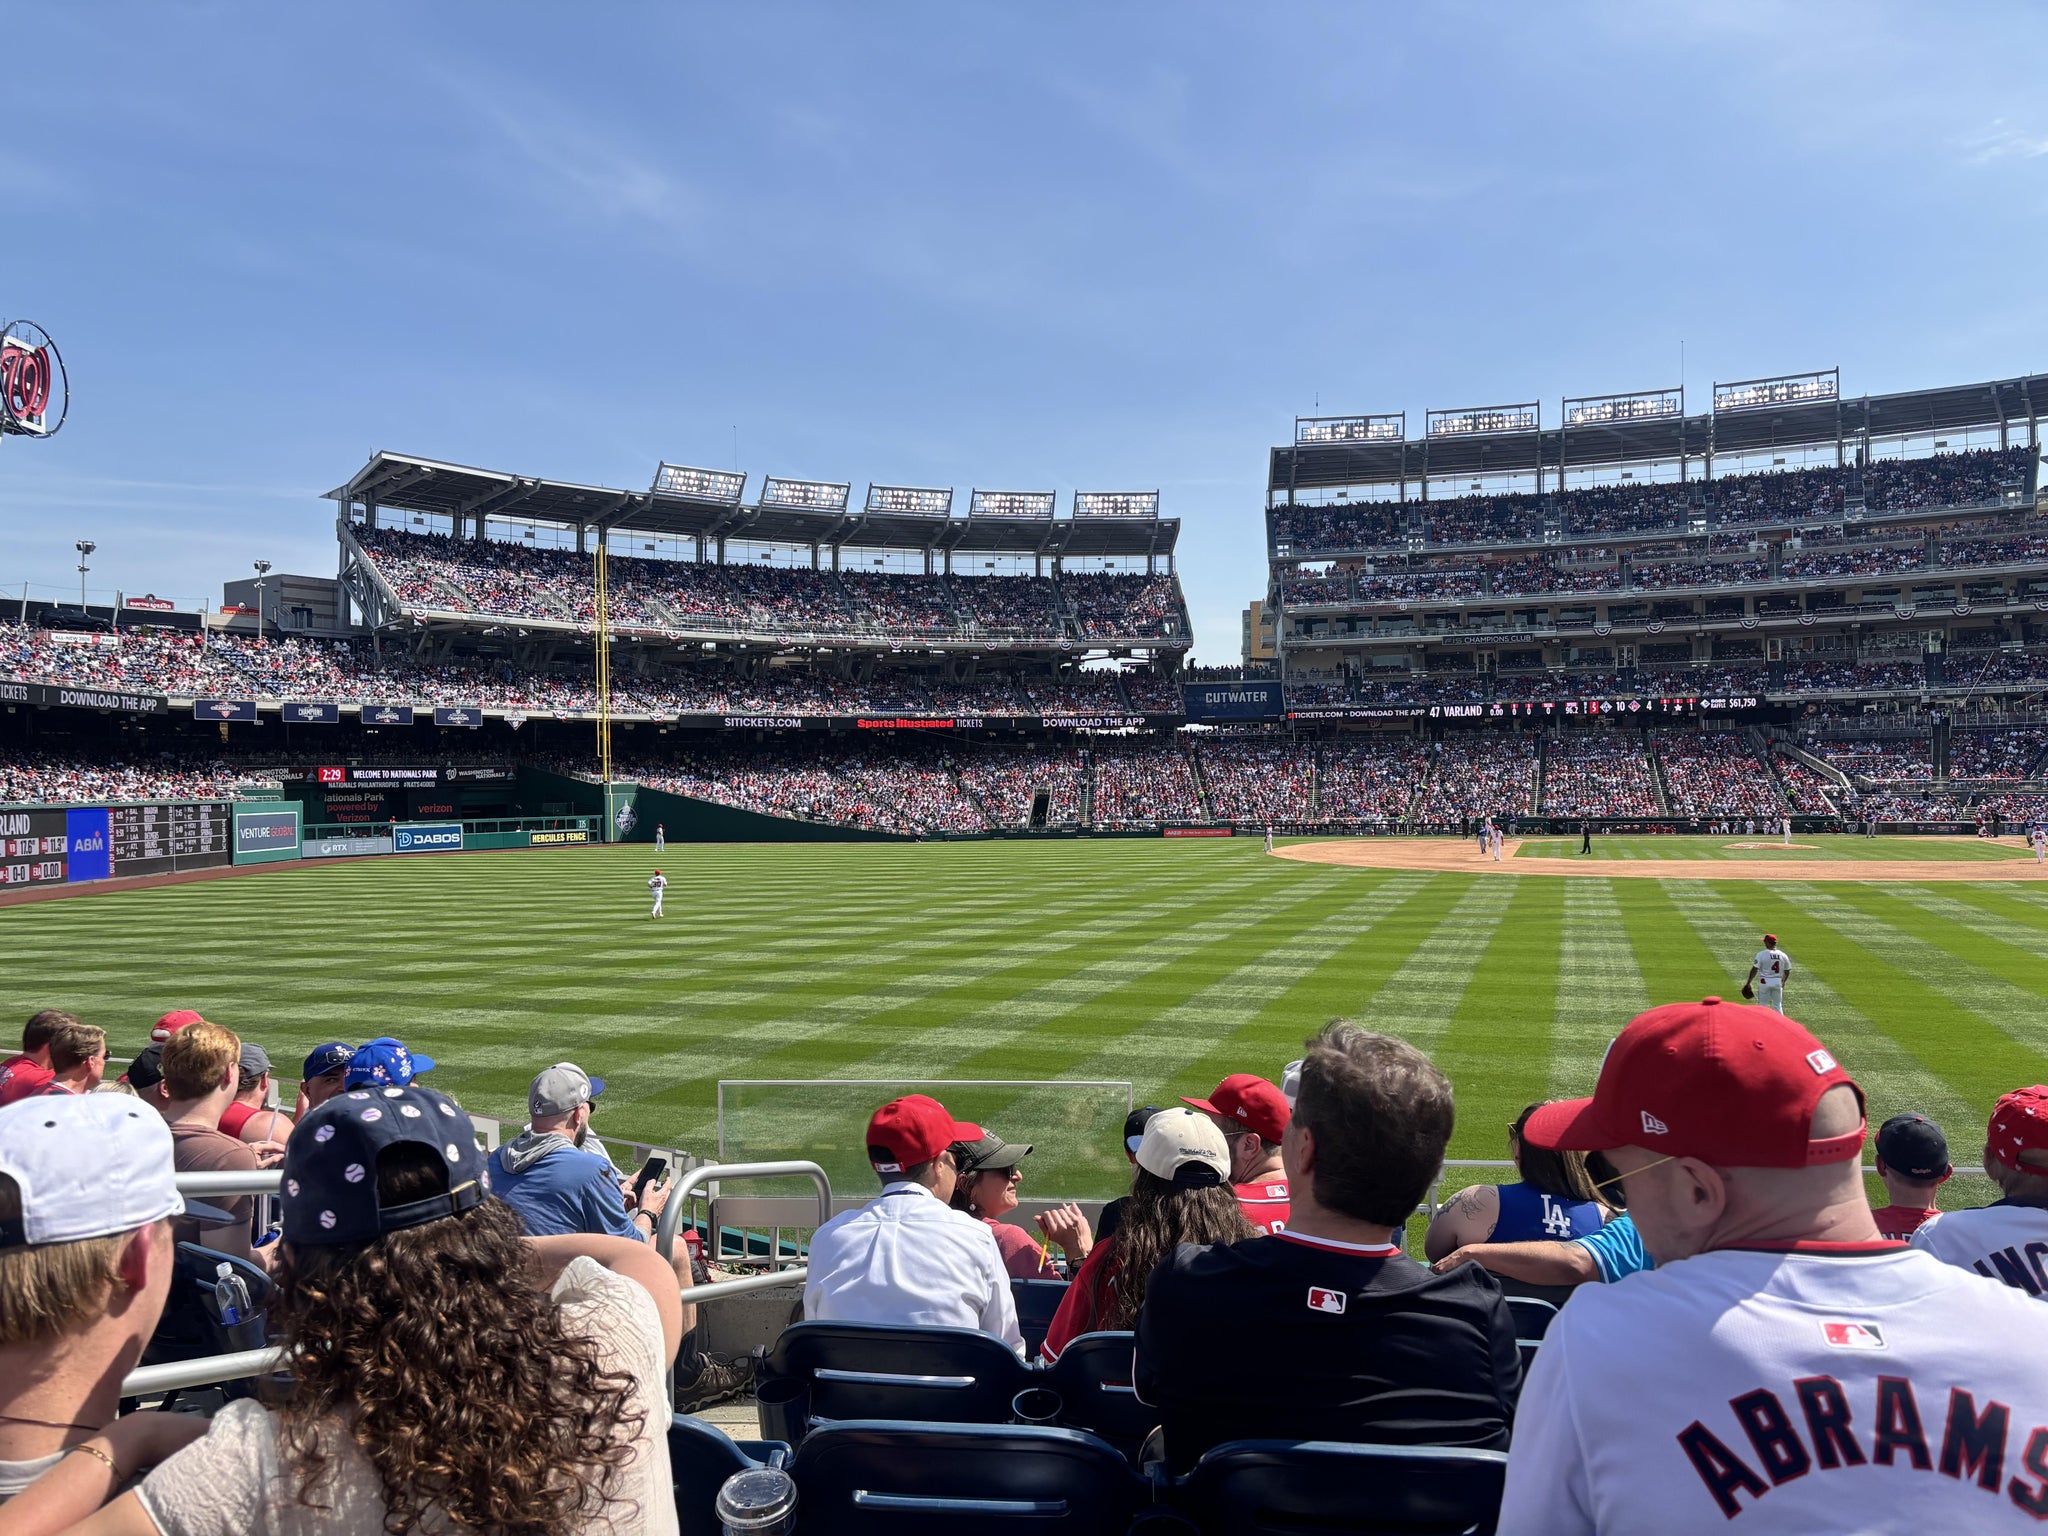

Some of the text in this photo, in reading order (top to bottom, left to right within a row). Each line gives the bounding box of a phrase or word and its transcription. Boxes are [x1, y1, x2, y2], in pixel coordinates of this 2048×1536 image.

[60, 690, 157, 712] DOWNLOAD THE APP
[1206, 692, 1268, 703] CUTWATER
[1729, 698, 1756, 708] $61,750
[1616, 701, 1625, 711] 10
[1646, 701, 1652, 710] 4
[1820, 704, 1844, 712] PNC
[1288, 711, 1343, 719] SITICKETS.COM
[1430, 707, 1440, 718] 47
[1444, 705, 1482, 717] VARLAND
[724, 718, 801, 728] SITICKETS.COM
[857, 718, 983, 729] Sports Illustrated TICKETS
[1042, 717, 1145, 728] DOWNLOAD THE APP
[323, 769, 341, 781] 2:29
[353, 770, 381, 778] WELCOME
[382, 770, 389, 778] TO
[390, 770, 421, 778] NATIONALS
[364, 793, 384, 802] Park
[327, 803, 378, 812] powered by
[418, 804, 452, 813] verizon
[337, 814, 370, 822] Verizon
[241, 826, 294, 839] VENTURE GLOBAL
[532, 832, 586, 843] HERCULES FENCE
[413, 833, 461, 845] DABOS
[74, 838, 103, 852] ABM
[13, 866, 26, 881] 0-0
[43, 863, 59, 878] 0.00
[1771, 961, 1779, 974] 4
[1541, 1194, 1570, 1238] LA
[1676, 1374, 2048, 1520] ABRAMS
